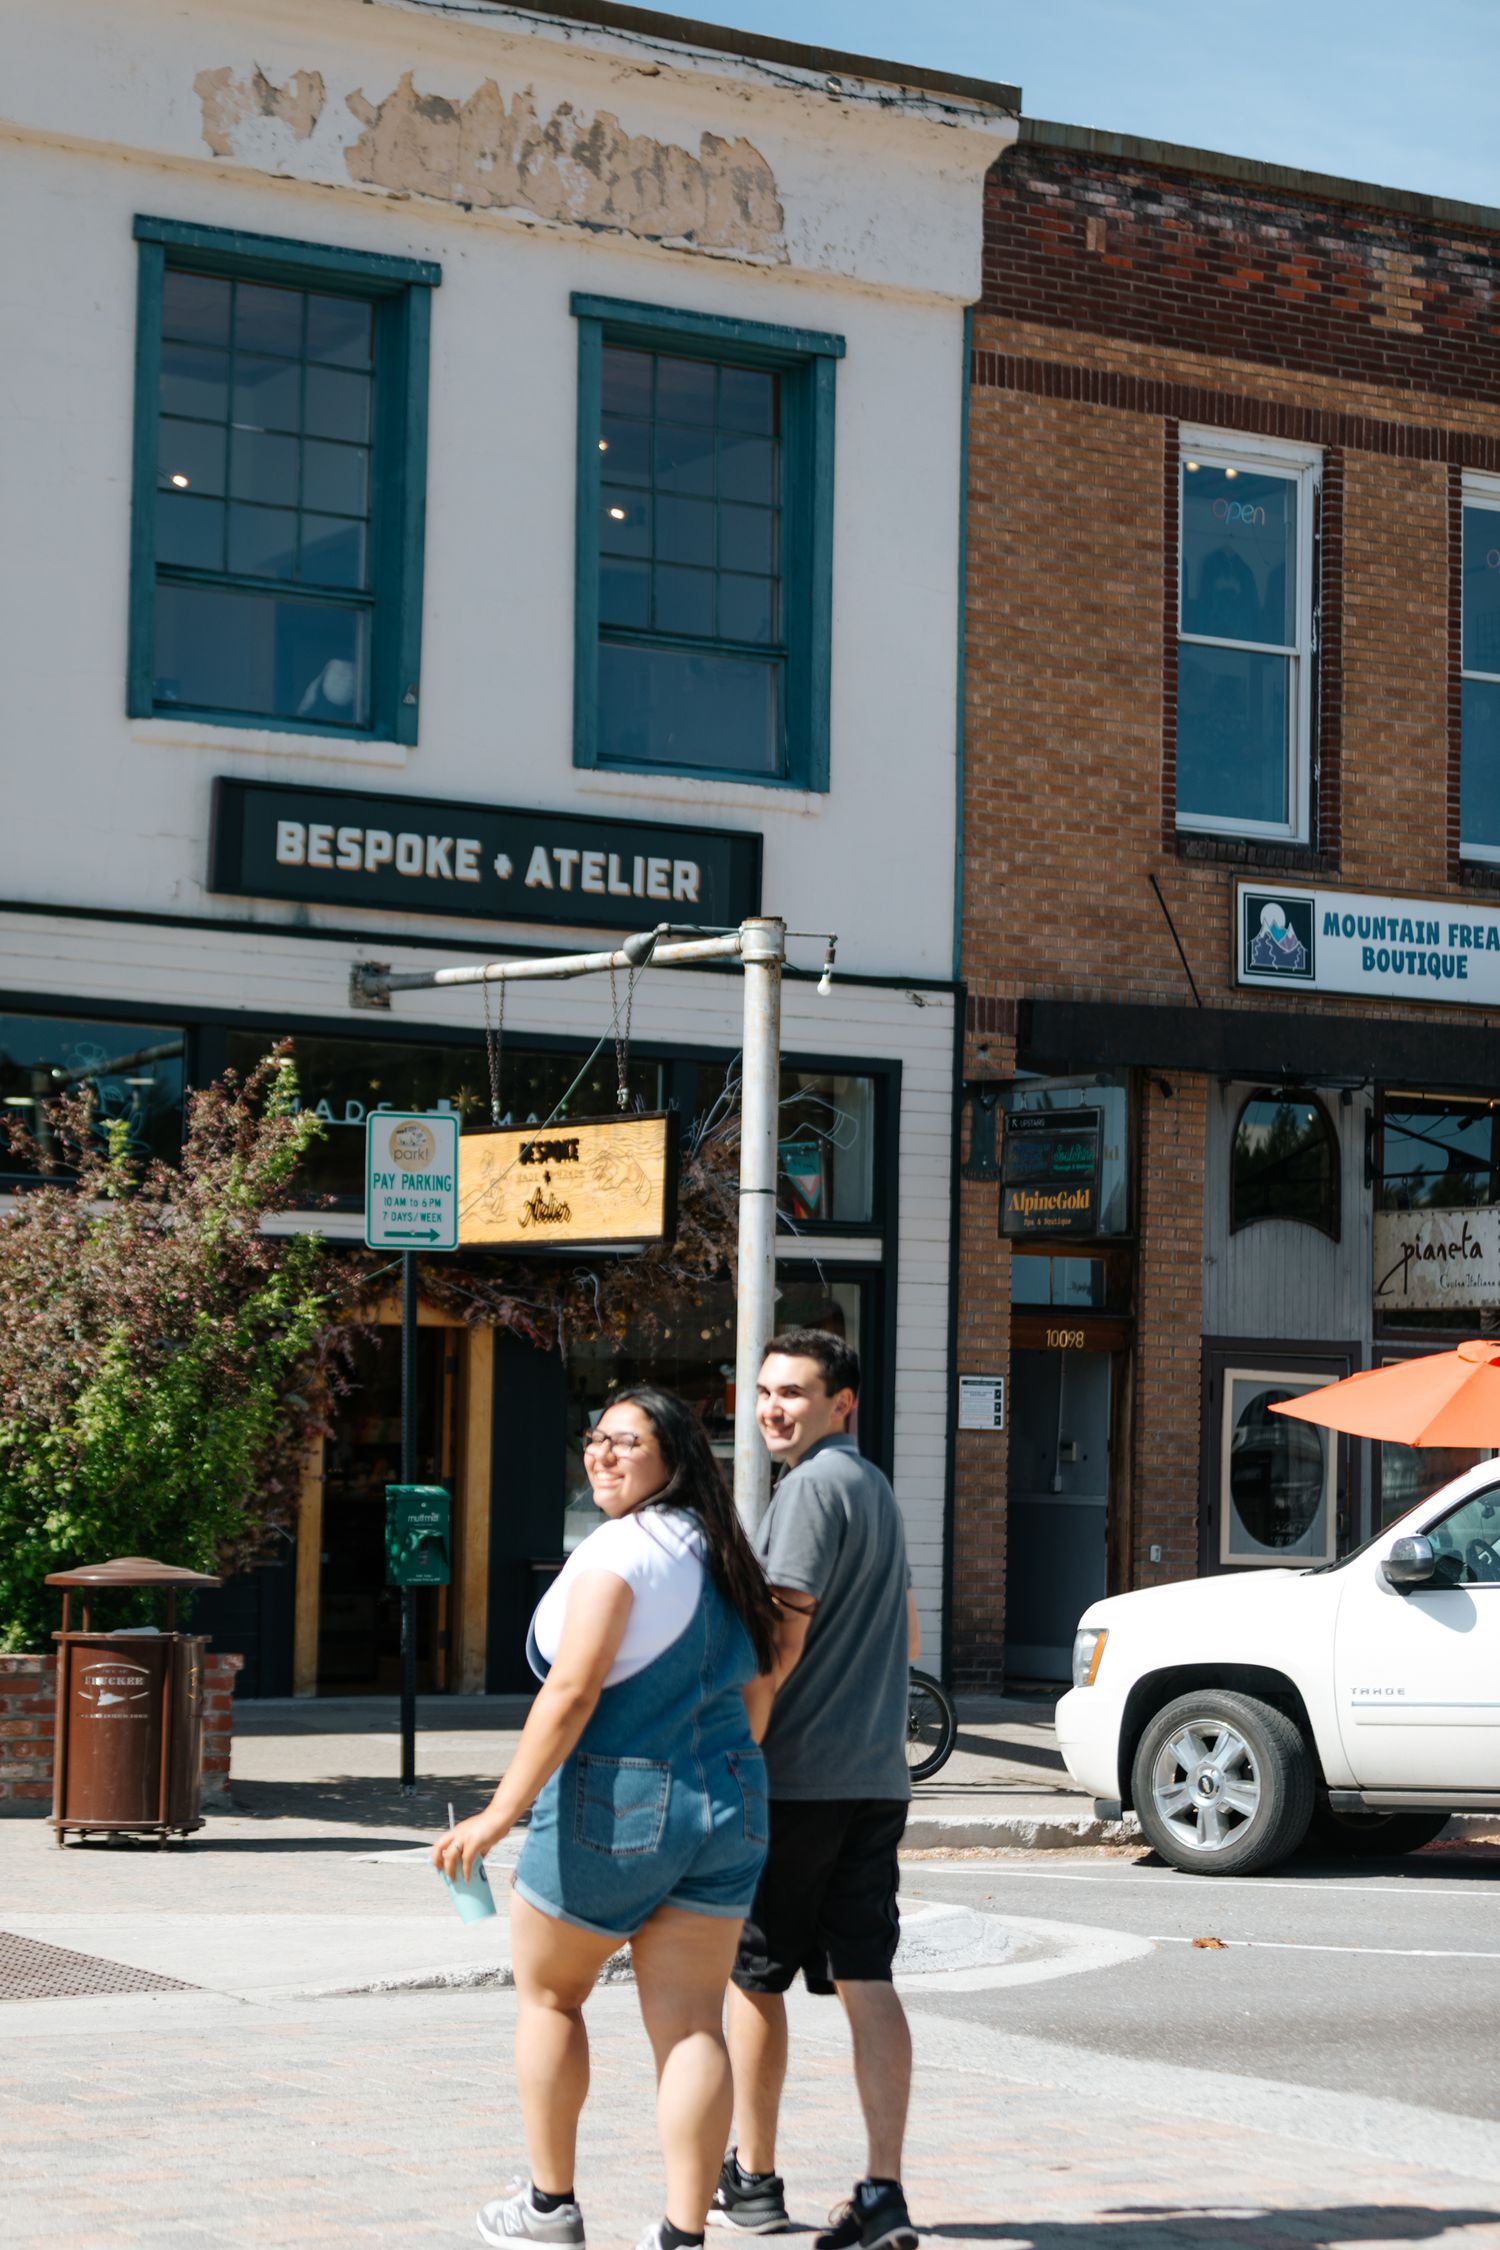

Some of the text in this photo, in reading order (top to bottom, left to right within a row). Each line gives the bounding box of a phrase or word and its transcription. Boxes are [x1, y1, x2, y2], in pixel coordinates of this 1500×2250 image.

[276, 820, 481, 882] BESPOKE
[524, 846, 700, 901] ATELIER
[1323, 912, 1440, 945] MOUNTAIN
[1362, 946, 1468, 980] BOUTIQUE
[373, 1173, 452, 1192] PAY PARKING
[1008, 1188, 1090, 1216] AlpineGold
[1376, 1221, 1484, 1296] pianeta
[1349, 1687, 1406, 1696] TAHOE
